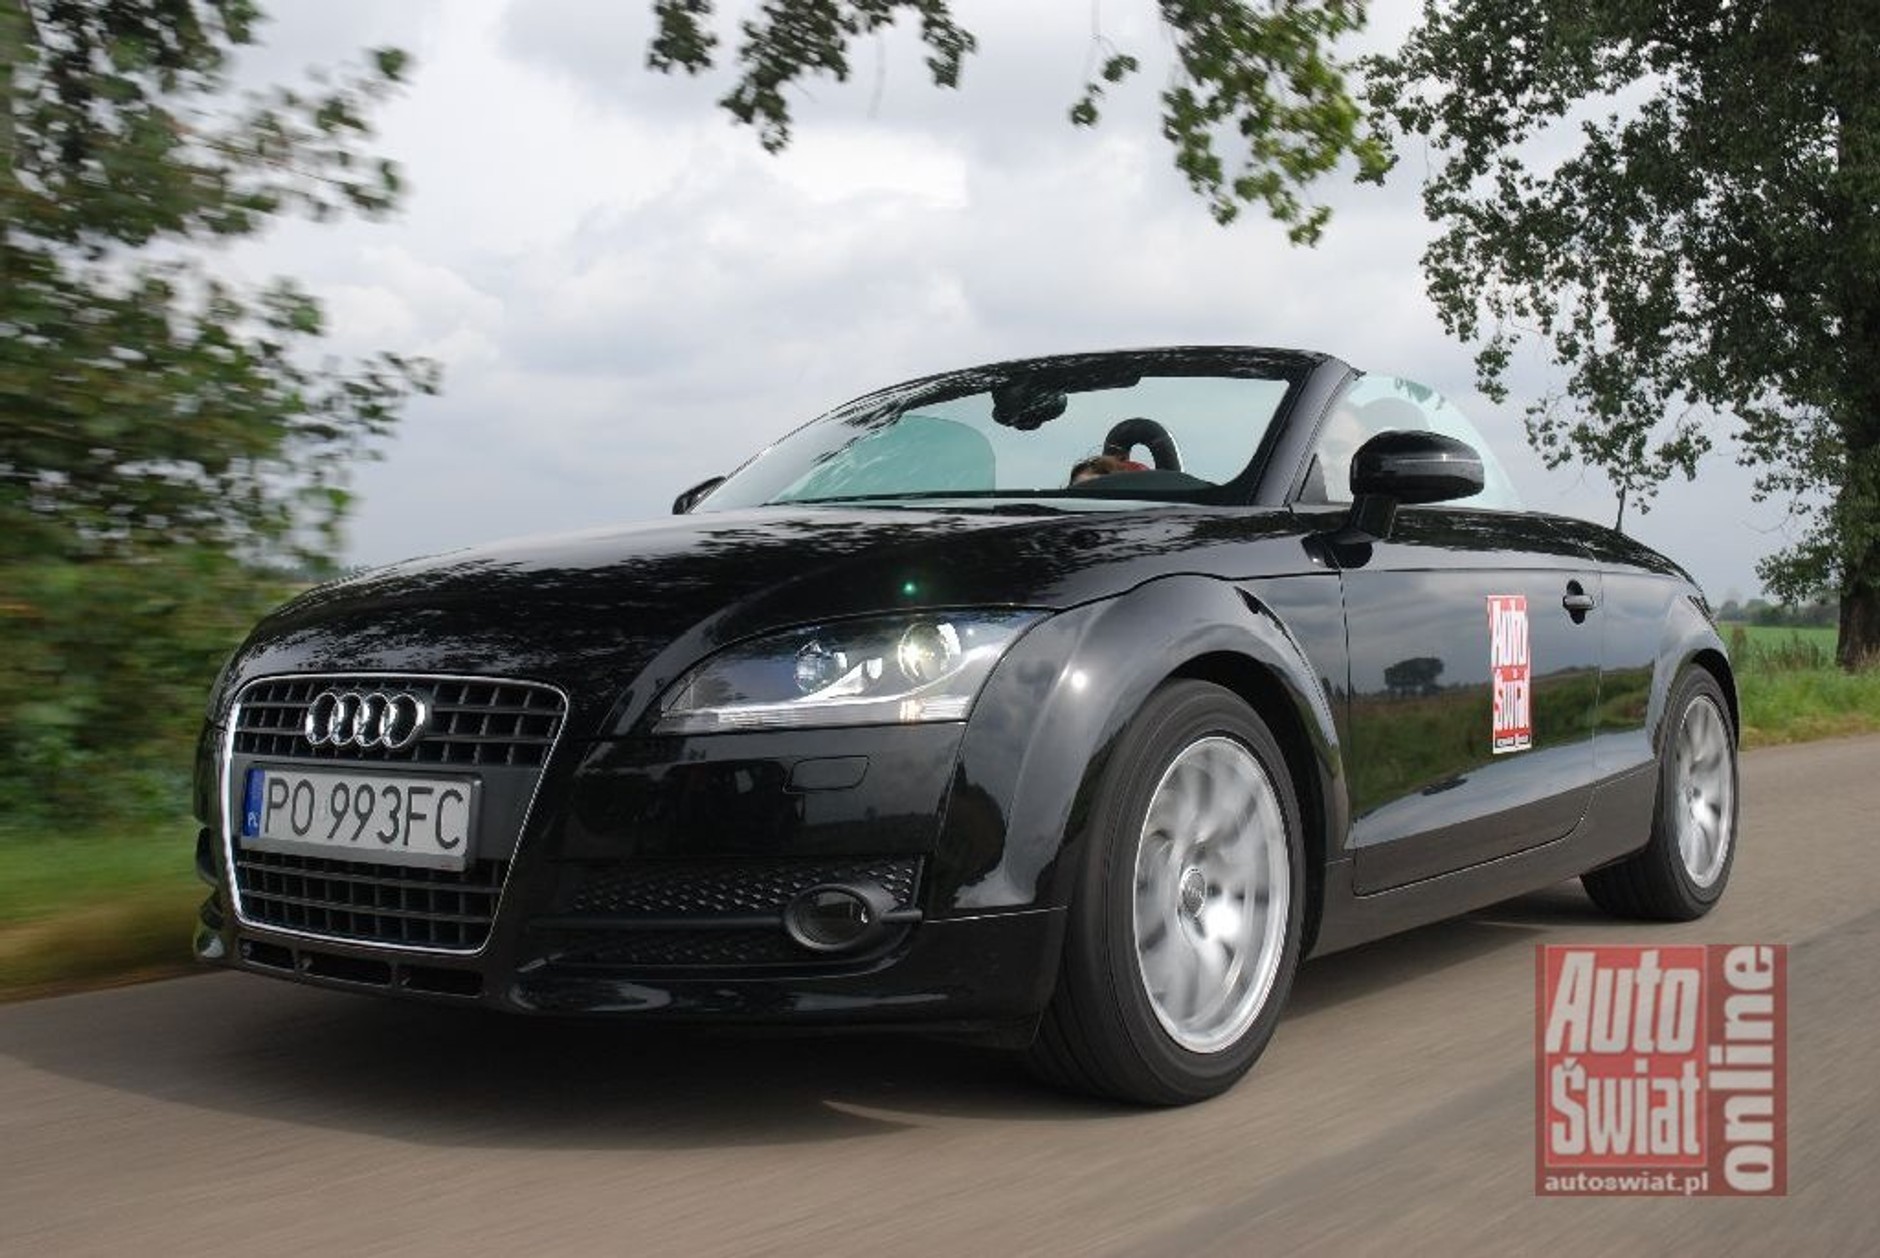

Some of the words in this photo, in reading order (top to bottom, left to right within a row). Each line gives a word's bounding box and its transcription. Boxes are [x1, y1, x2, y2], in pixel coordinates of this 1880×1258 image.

[1491, 599, 1529, 667] Auto
[264, 777, 315, 836] PO
[326, 781, 464, 849] 993FC
